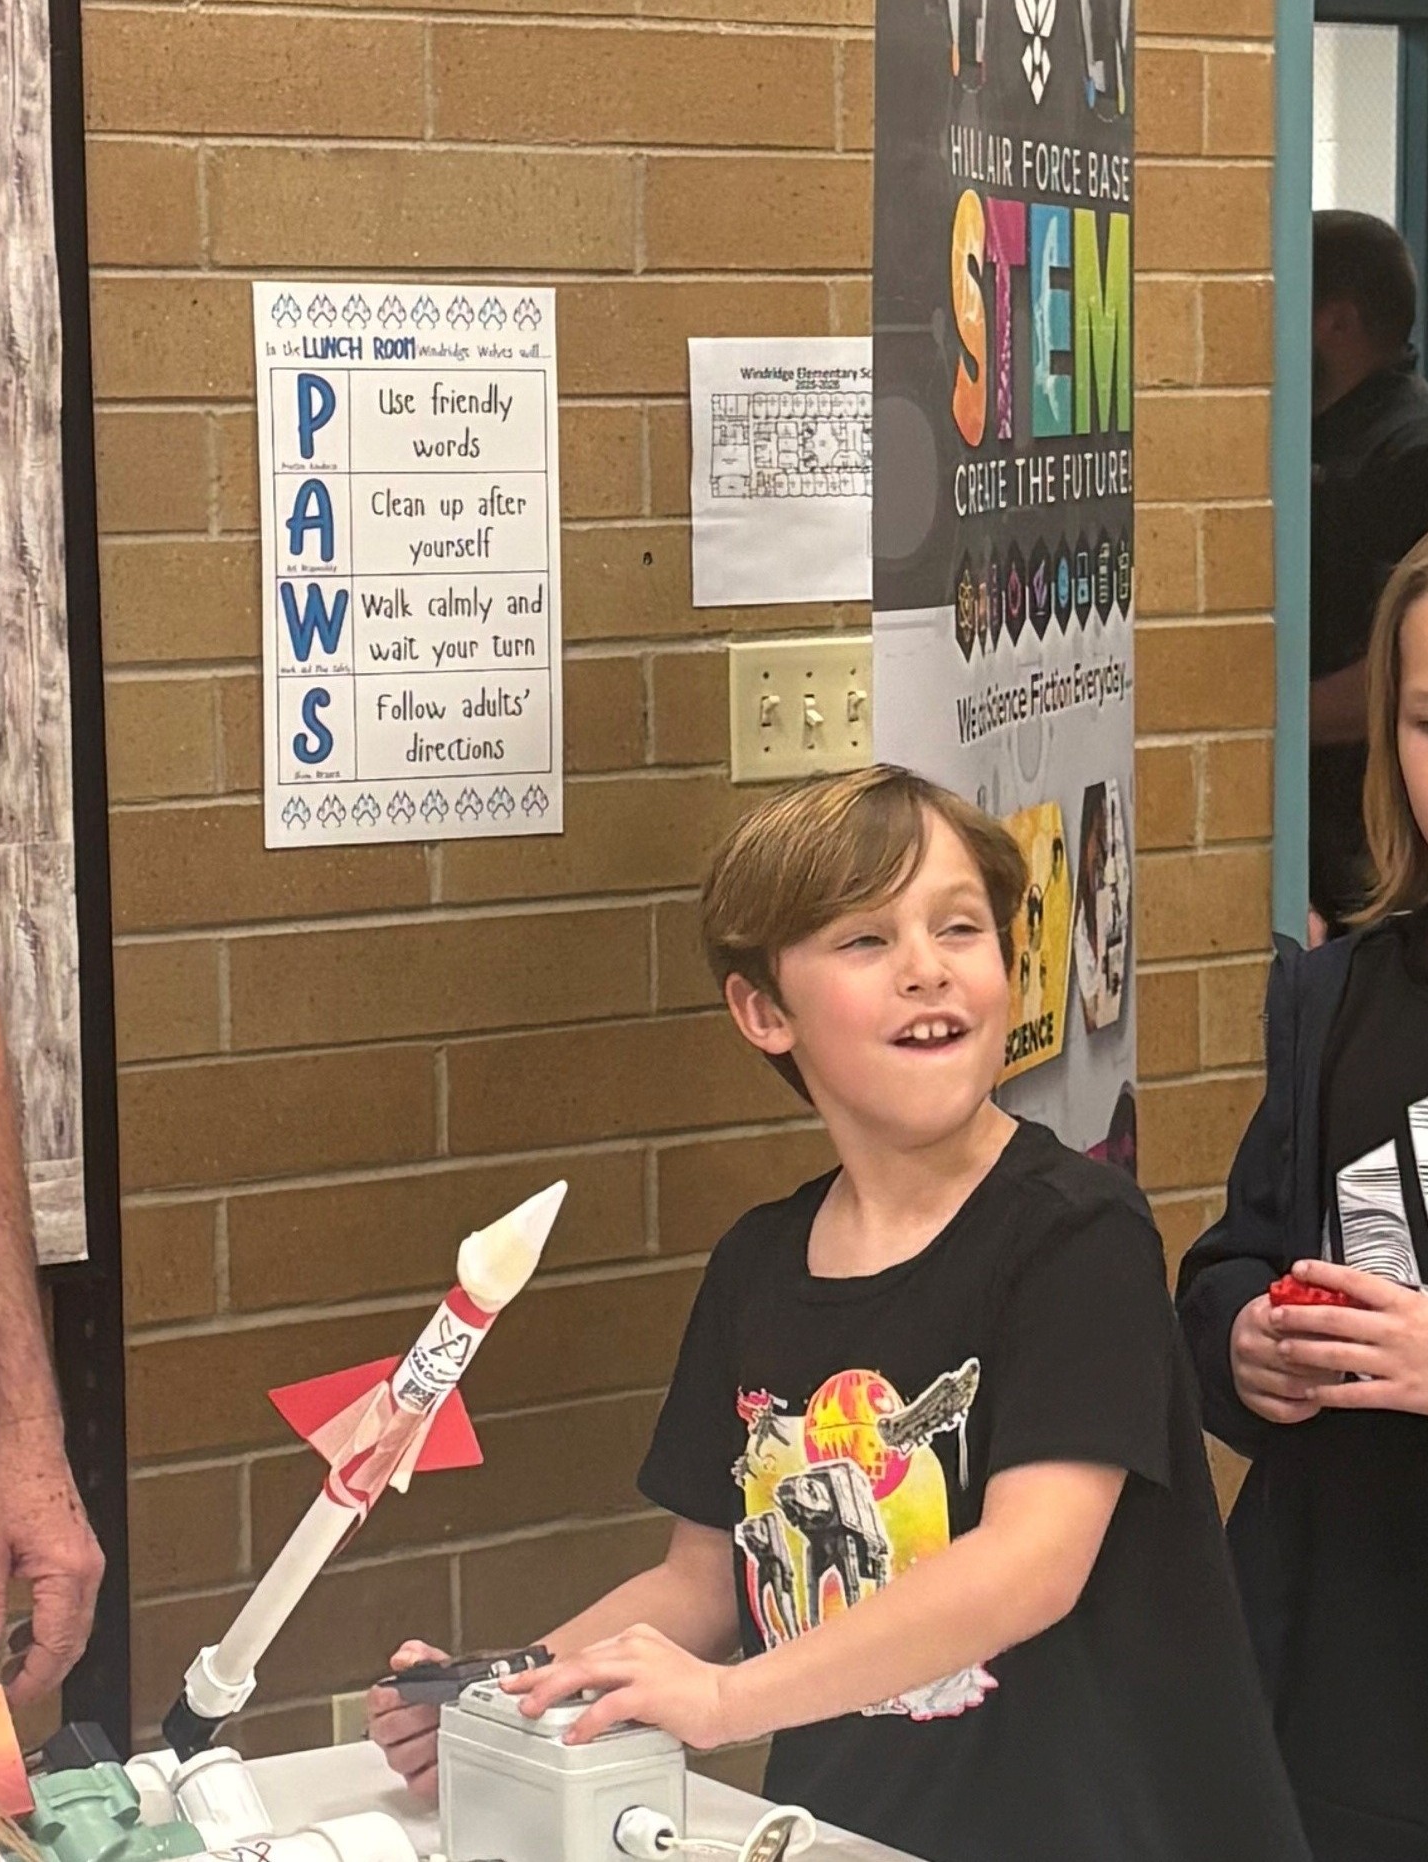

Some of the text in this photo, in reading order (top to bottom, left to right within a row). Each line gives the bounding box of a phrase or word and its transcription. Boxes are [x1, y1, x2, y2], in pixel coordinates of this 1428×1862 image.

[951, 124, 1130, 202] HILL AIR FORCE BASE
[951, 189, 1130, 447] STEM
[303, 335, 362, 360] LUNCH
[374, 336, 415, 360] ROOM
[740, 367, 794, 382] Windridge
[797, 367, 857, 381] Elementary
[297, 373, 336, 460] P
[379, 382, 513, 422] Use friendly
[413, 427, 481, 458] words
[372, 485, 527, 521] Clean up after
[955, 449, 1132, 517] CREATE THE FUTURE!
[286, 478, 334, 562] A
[410, 527, 494, 566] yourself
[280, 581, 349, 662] W
[361, 583, 543, 624] Walk calmly and
[369, 635, 535, 667] wait your turn
[377, 686, 530, 720] Follow adults'
[1031, 668, 1072, 716] Fiction
[293, 687, 333, 764] S
[406, 732, 505, 762] directions
